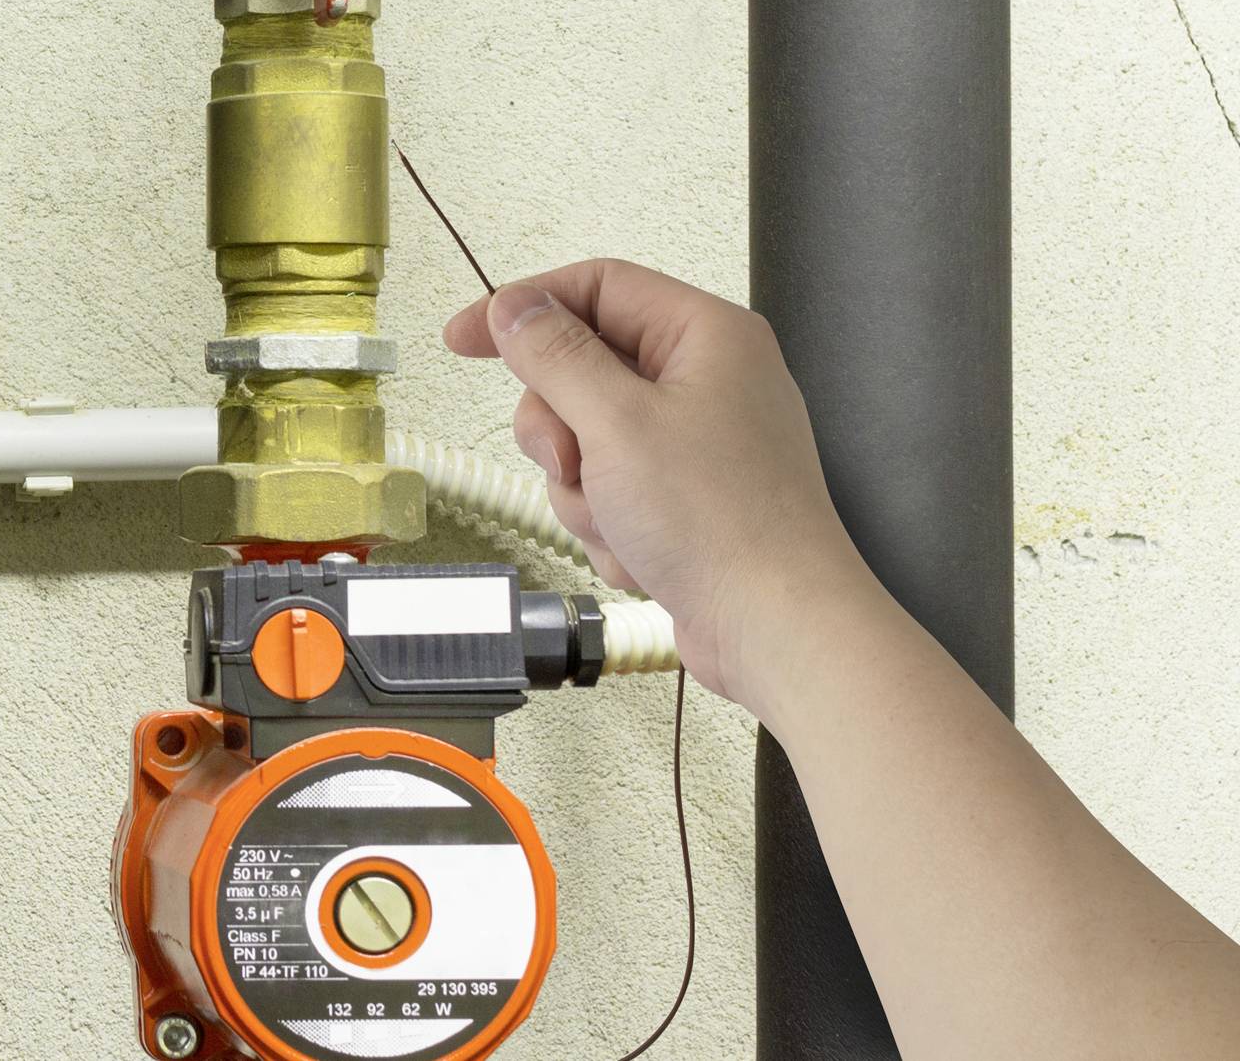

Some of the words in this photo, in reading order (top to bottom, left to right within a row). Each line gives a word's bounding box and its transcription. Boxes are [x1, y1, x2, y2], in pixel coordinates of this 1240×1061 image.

[239, 849, 266, 863] 230
[270, 849, 281, 863] V
[232, 867, 250, 880] 50
[254, 867, 274, 880] Hz
[226, 887, 254, 897] max
[258, 885, 288, 899] 0,58
[290, 885, 302, 897] A
[235, 907, 256, 921] 3,5
[274, 907, 284, 920] F
[227, 929, 268, 943] Class
[272, 929, 281, 943] F
[234, 947, 256, 960] PN
[261, 947, 278, 960] 10
[242, 965, 256, 978] IP
[304, 965, 328, 978] 110
[418, 983, 436, 996] 29
[441, 983, 466, 995] 130
[470, 983, 498, 995] 395
[326, 1003, 352, 1017] 132
[366, 1003, 385, 1017] 92
[402, 1003, 420, 1017] 62
[435, 1003, 452, 1016] W
